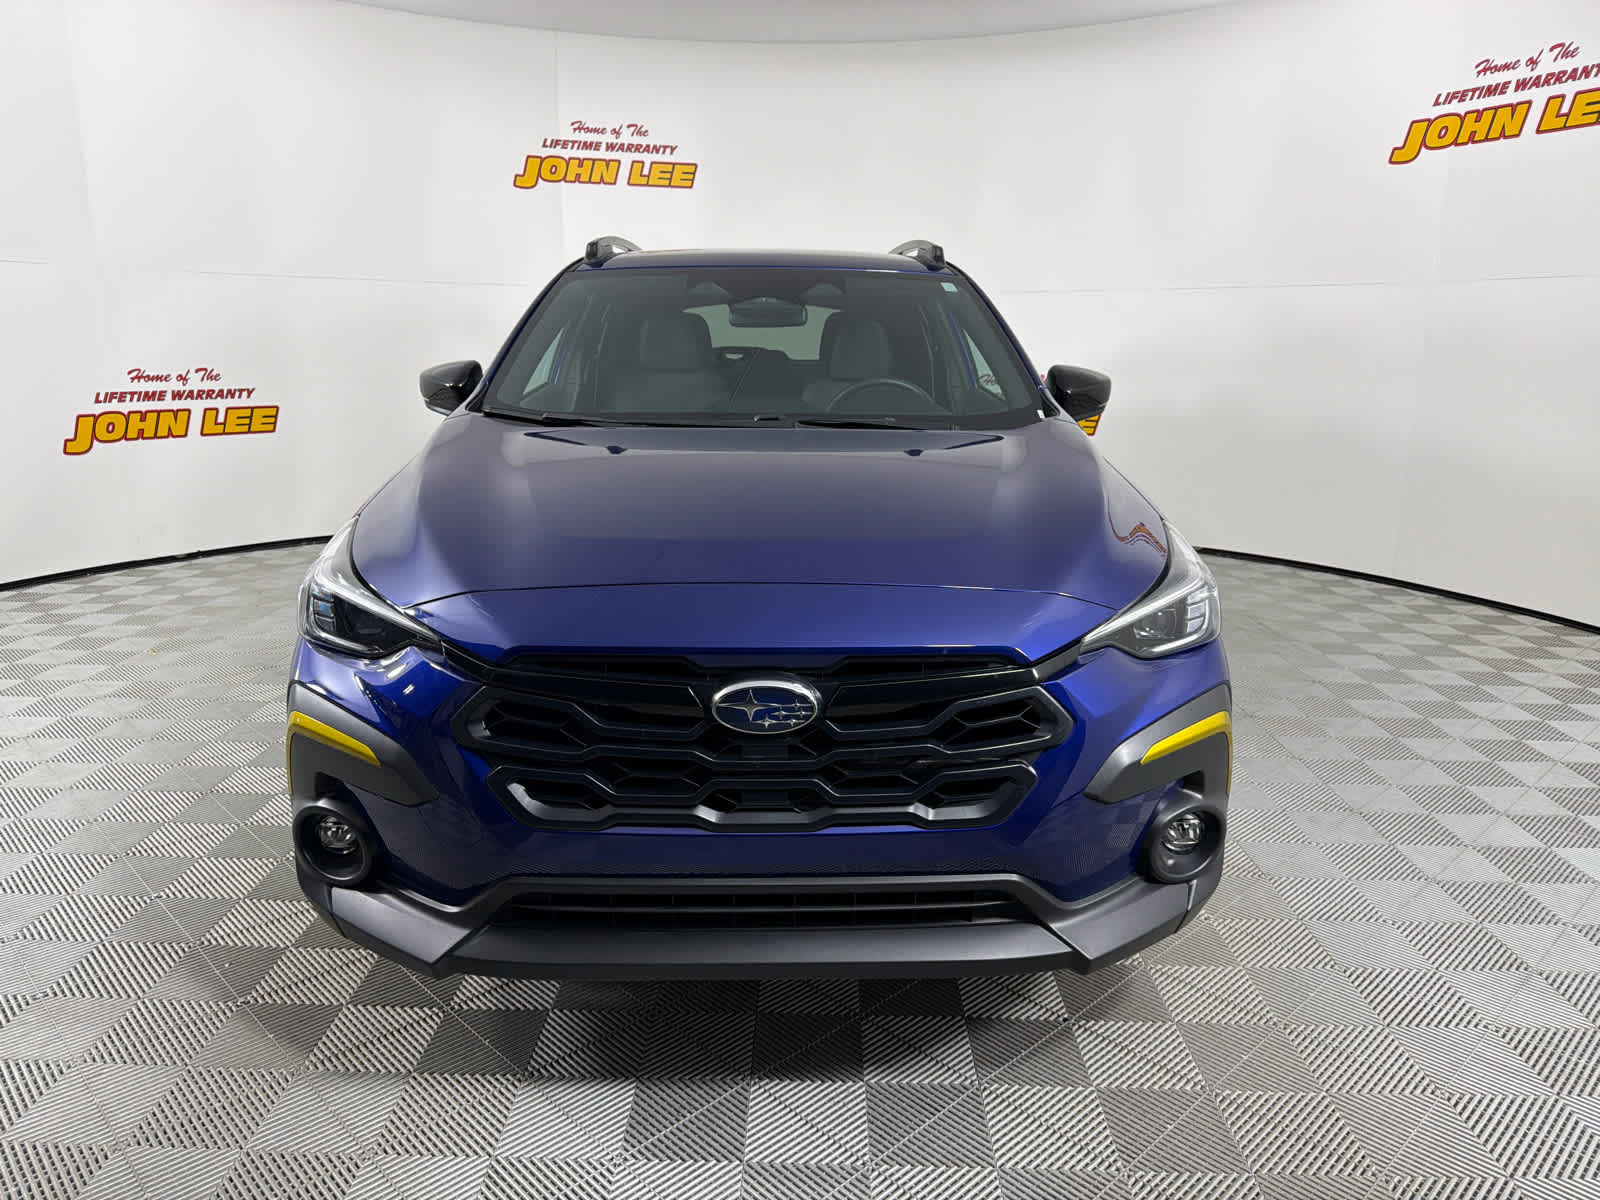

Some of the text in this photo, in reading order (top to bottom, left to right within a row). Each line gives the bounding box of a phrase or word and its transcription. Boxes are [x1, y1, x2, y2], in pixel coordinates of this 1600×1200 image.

[1475, 41, 1580, 78] Home of The
[1432, 80, 1512, 107] LIFETIME
[571, 121, 649, 139] Home of The
[1388, 99, 1533, 165] JOHN
[541, 138, 678, 155] LIFETIME WARRANTY
[513, 155, 698, 189] JOHN LEE
[127, 367, 222, 386] Home of The
[94, 388, 256, 404] LIFETIME WARRANTY
[63, 405, 279, 456] JOHN LEE
